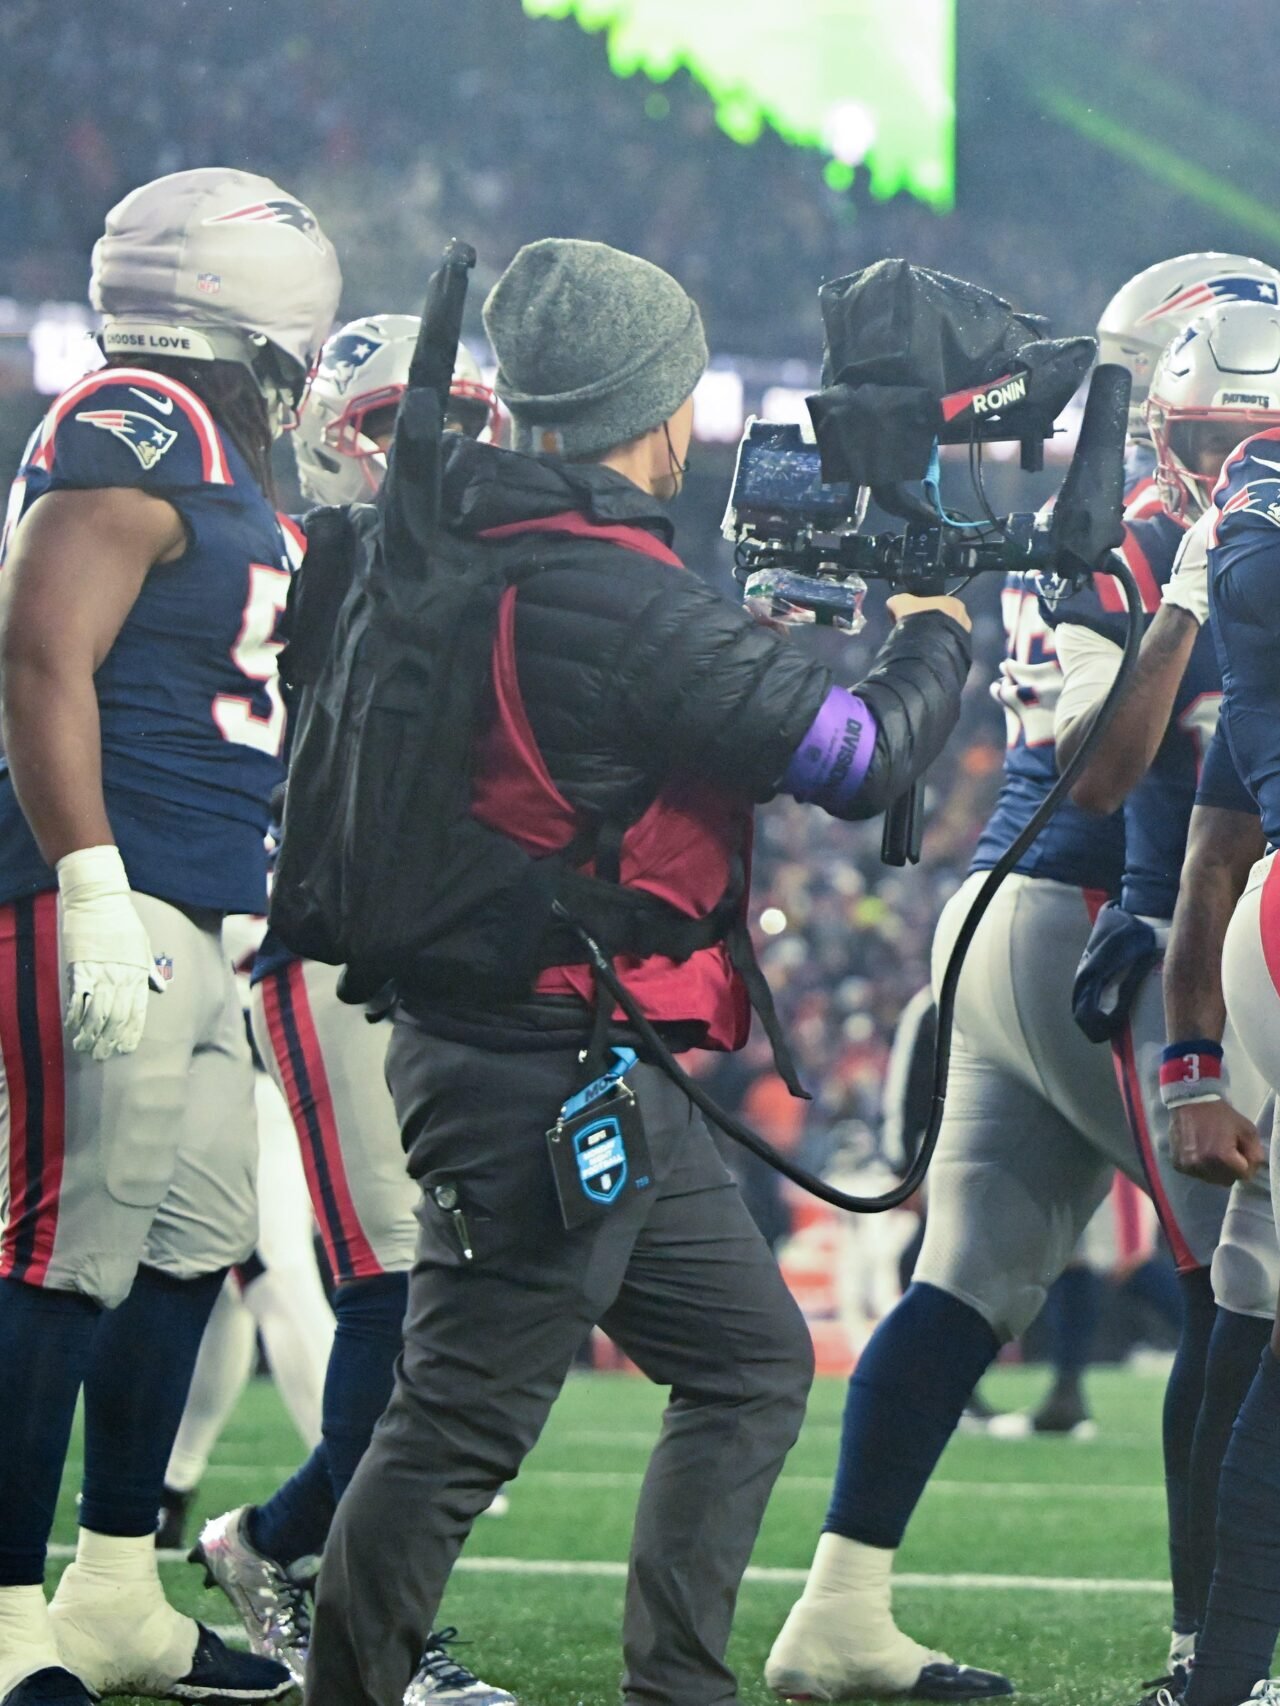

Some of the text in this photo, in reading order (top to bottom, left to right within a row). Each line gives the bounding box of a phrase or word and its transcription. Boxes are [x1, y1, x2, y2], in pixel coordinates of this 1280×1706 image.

[149, 335, 191, 350] LOVE
[972, 378, 1026, 414] RONIN
[1183, 1053, 1200, 1083] 3
